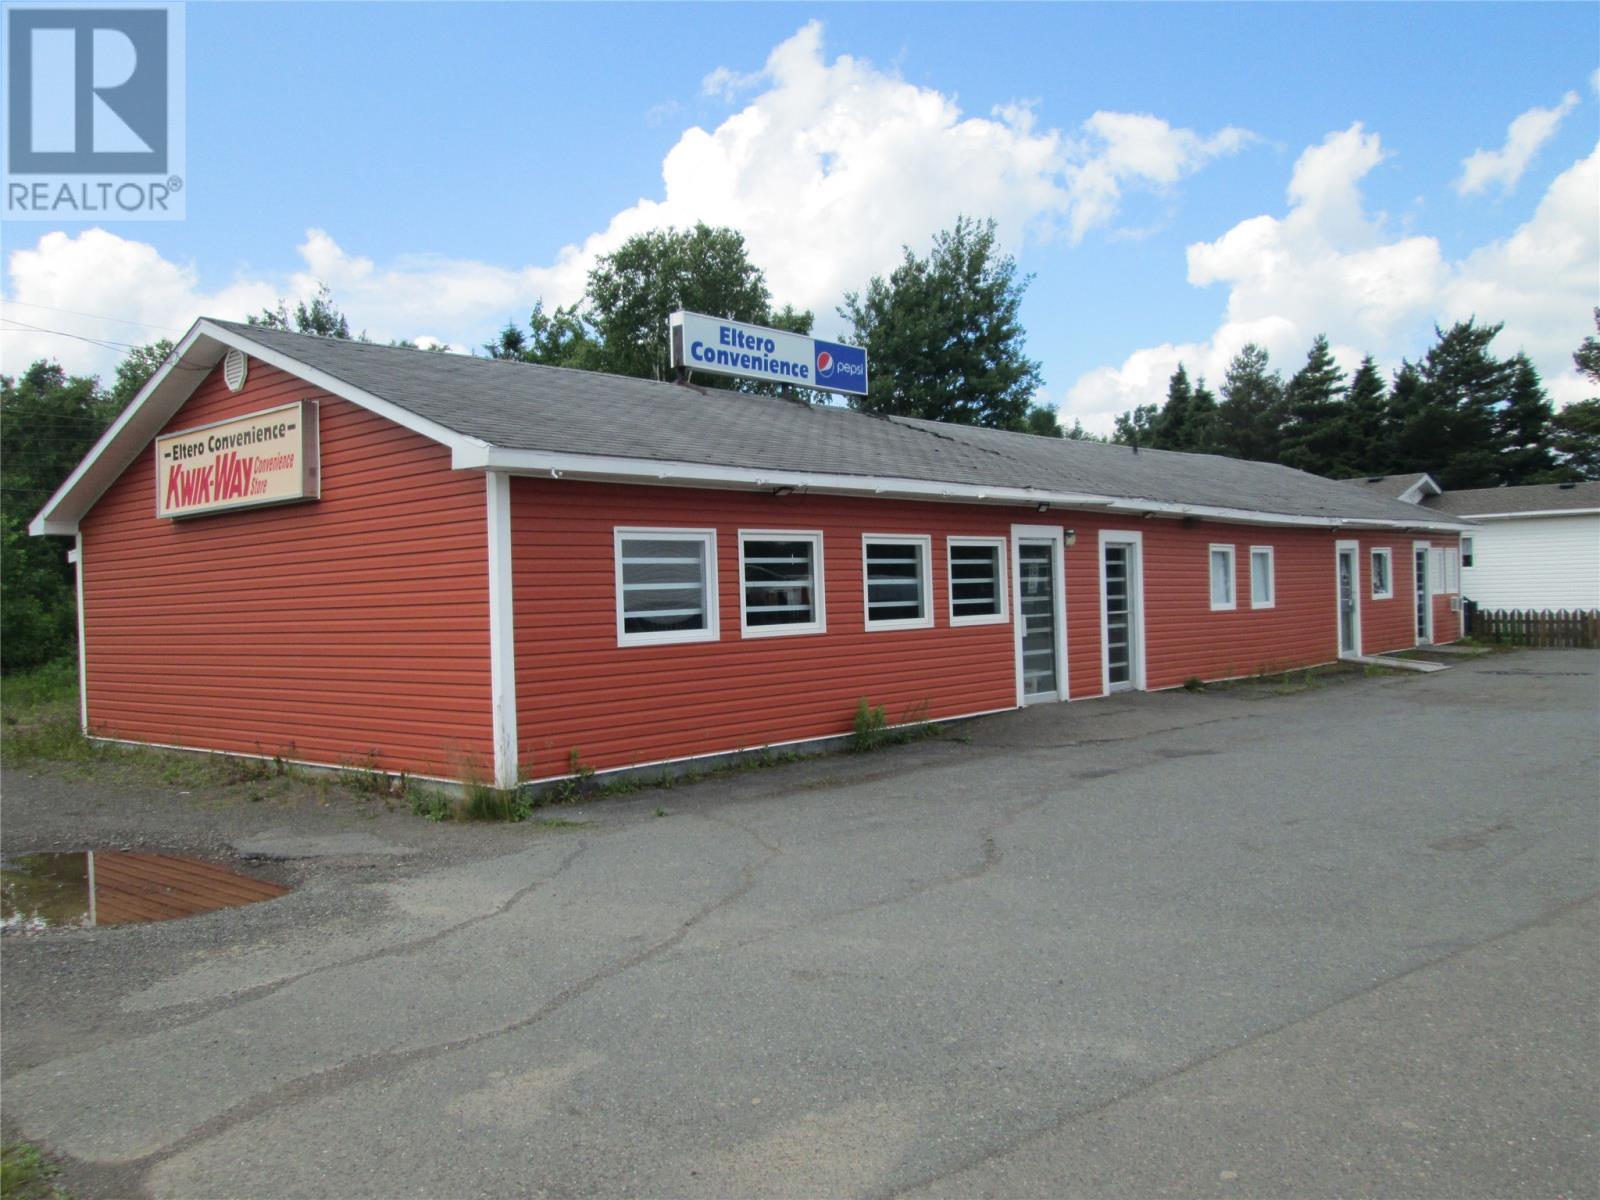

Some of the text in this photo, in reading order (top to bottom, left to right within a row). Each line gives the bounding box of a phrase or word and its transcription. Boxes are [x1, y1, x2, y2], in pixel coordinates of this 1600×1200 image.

[719, 325, 776, 354] Eltero
[690, 340, 809, 379] Convenience
[836, 360, 864, 377] pepsi
[253, 451, 295, 474] Convenience
[250, 476, 268, 496] Store
